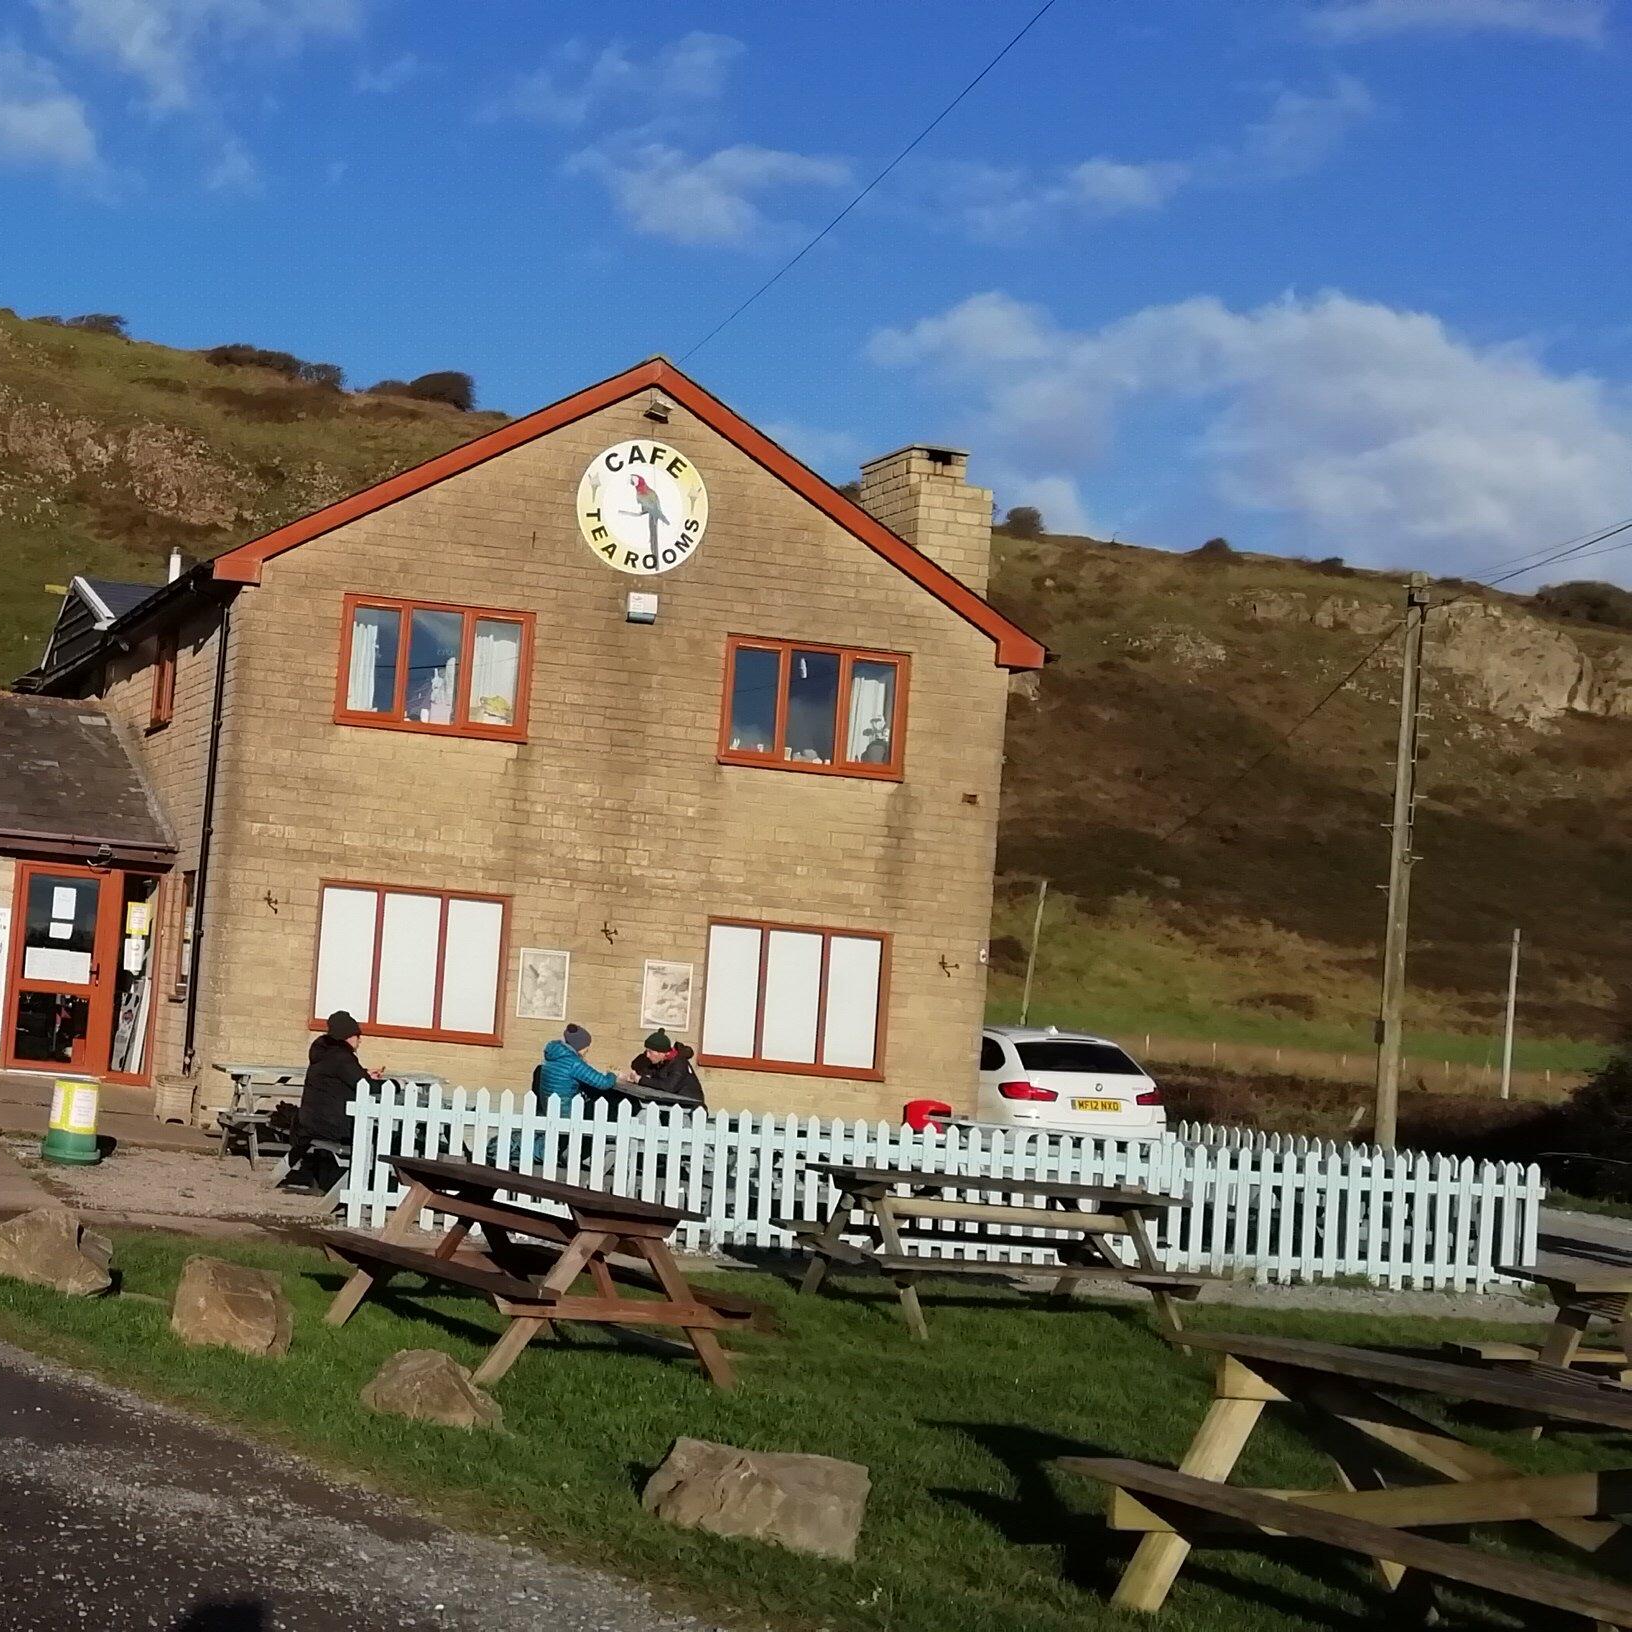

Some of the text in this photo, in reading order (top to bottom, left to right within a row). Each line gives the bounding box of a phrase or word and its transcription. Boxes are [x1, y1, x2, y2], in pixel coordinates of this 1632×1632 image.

[605, 445, 687, 479] CAFE
[586, 508, 700, 570] TEA ROOMS
